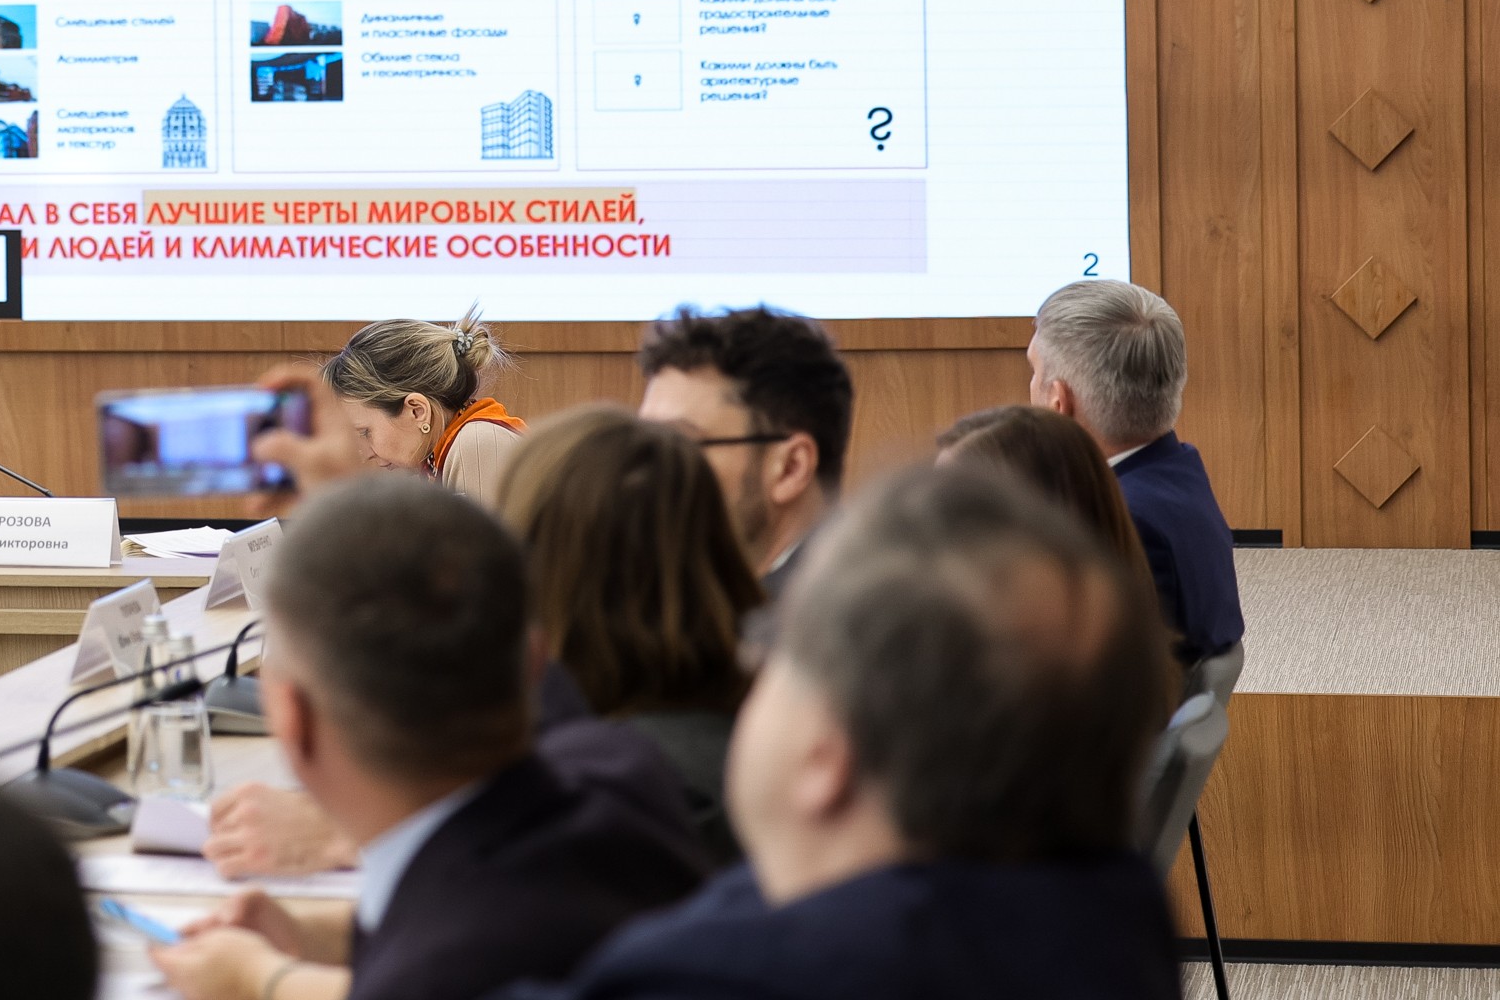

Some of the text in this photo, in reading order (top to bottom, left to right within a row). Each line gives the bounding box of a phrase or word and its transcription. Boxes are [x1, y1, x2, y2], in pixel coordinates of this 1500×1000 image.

[46, 203, 60, 225] В
[69, 201, 137, 225] СЕБЯ
[146, 202, 266, 225] ЛУЧШИЕ
[273, 201, 358, 224] ЧЕРТЫ
[368, 200, 516, 224] МИРОВЫХ
[525, 193, 645, 226] СТИЛЕЙ,
[48, 231, 154, 261] ЛЮДЕЙ
[165, 236, 182, 258] И
[193, 235, 437, 259] КЛИМАТИЧЕСКИЕ
[446, 234, 670, 258] ОСОБЕННОСТИ
[1082, 252, 1099, 277] 2
